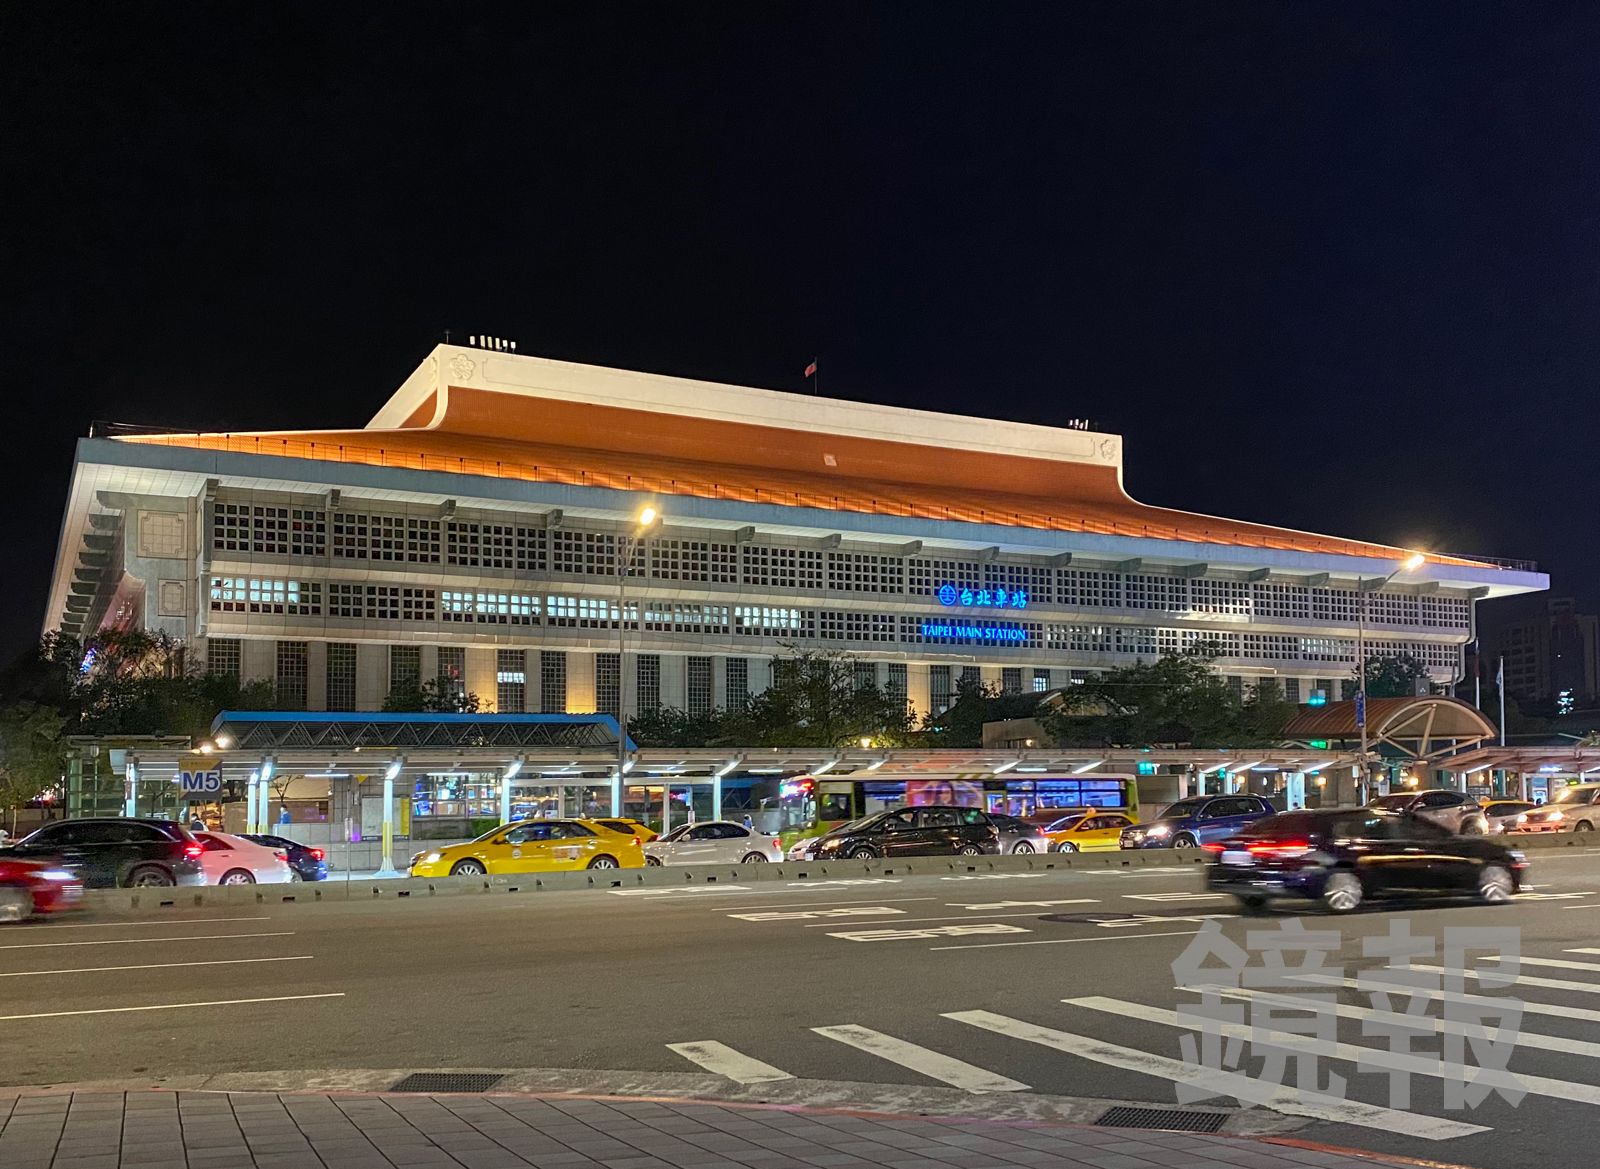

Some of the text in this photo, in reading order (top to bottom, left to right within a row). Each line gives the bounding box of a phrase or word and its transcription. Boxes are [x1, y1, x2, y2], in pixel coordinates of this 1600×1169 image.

[960, 587, 1027, 608] 台北車站
[922, 624, 1026, 640] TAIPEI MAIN STATION
[182, 770, 220, 792] M5
